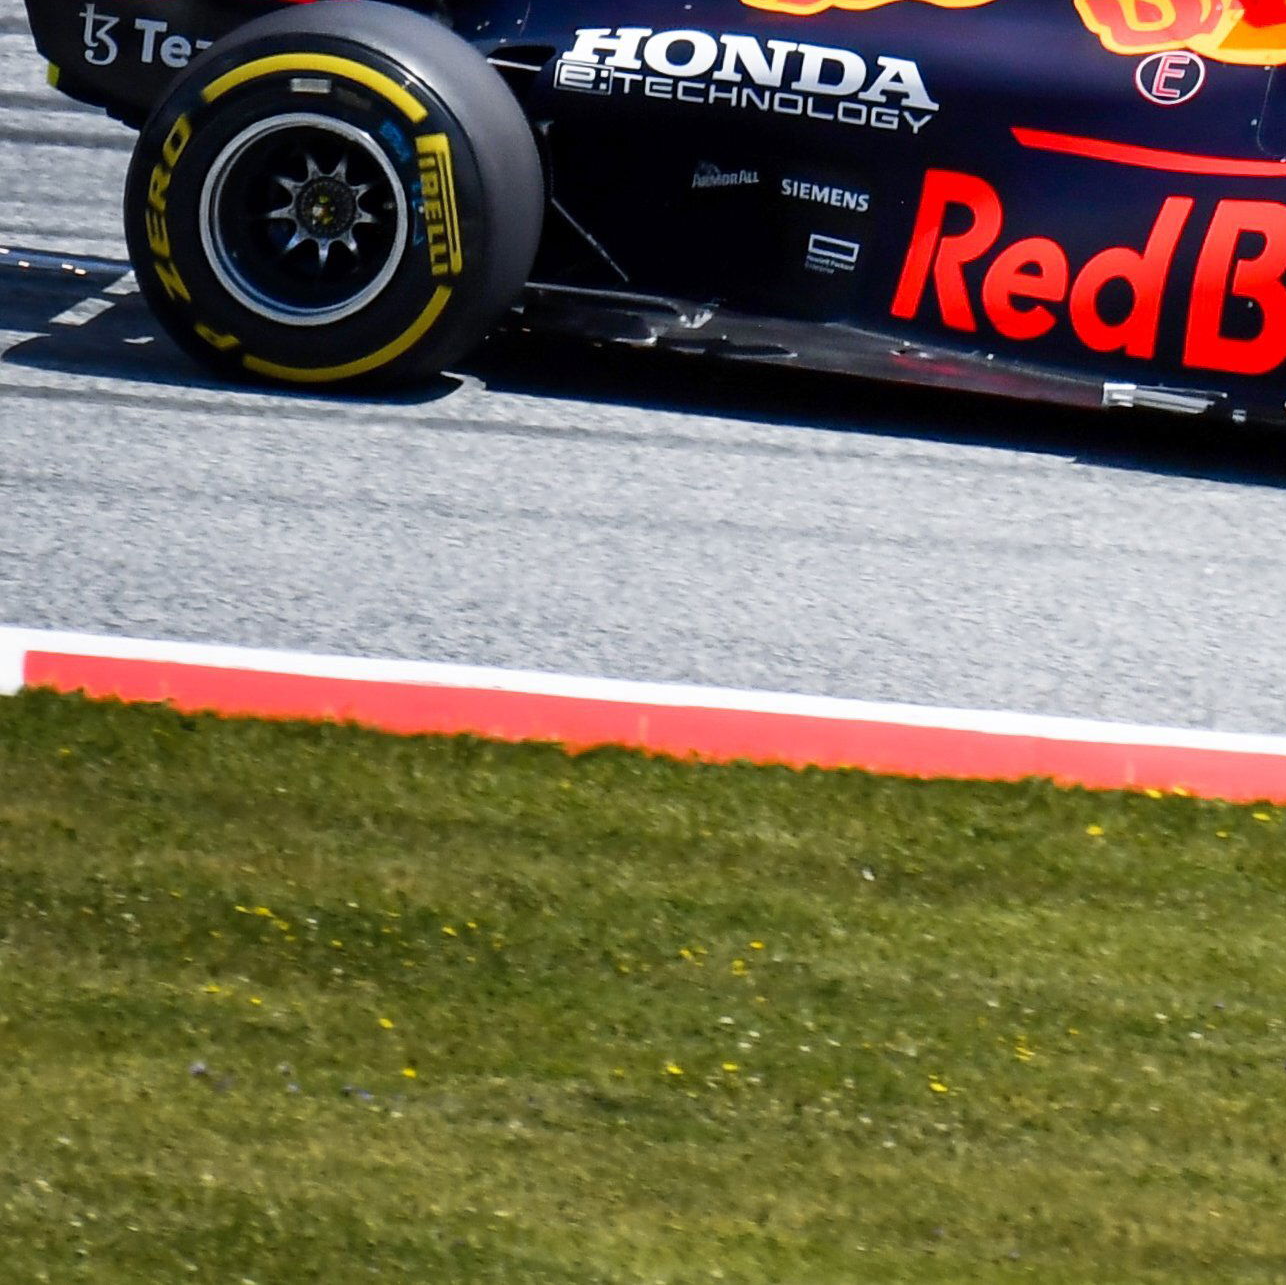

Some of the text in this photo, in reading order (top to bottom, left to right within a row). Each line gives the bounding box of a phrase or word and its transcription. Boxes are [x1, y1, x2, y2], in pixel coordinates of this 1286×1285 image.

[560, 26, 940, 112] HONDA
[145, 113, 193, 303] ZERO
[414, 133, 463, 277] PIRELLI
[780, 178, 871, 212] SIEMENS
